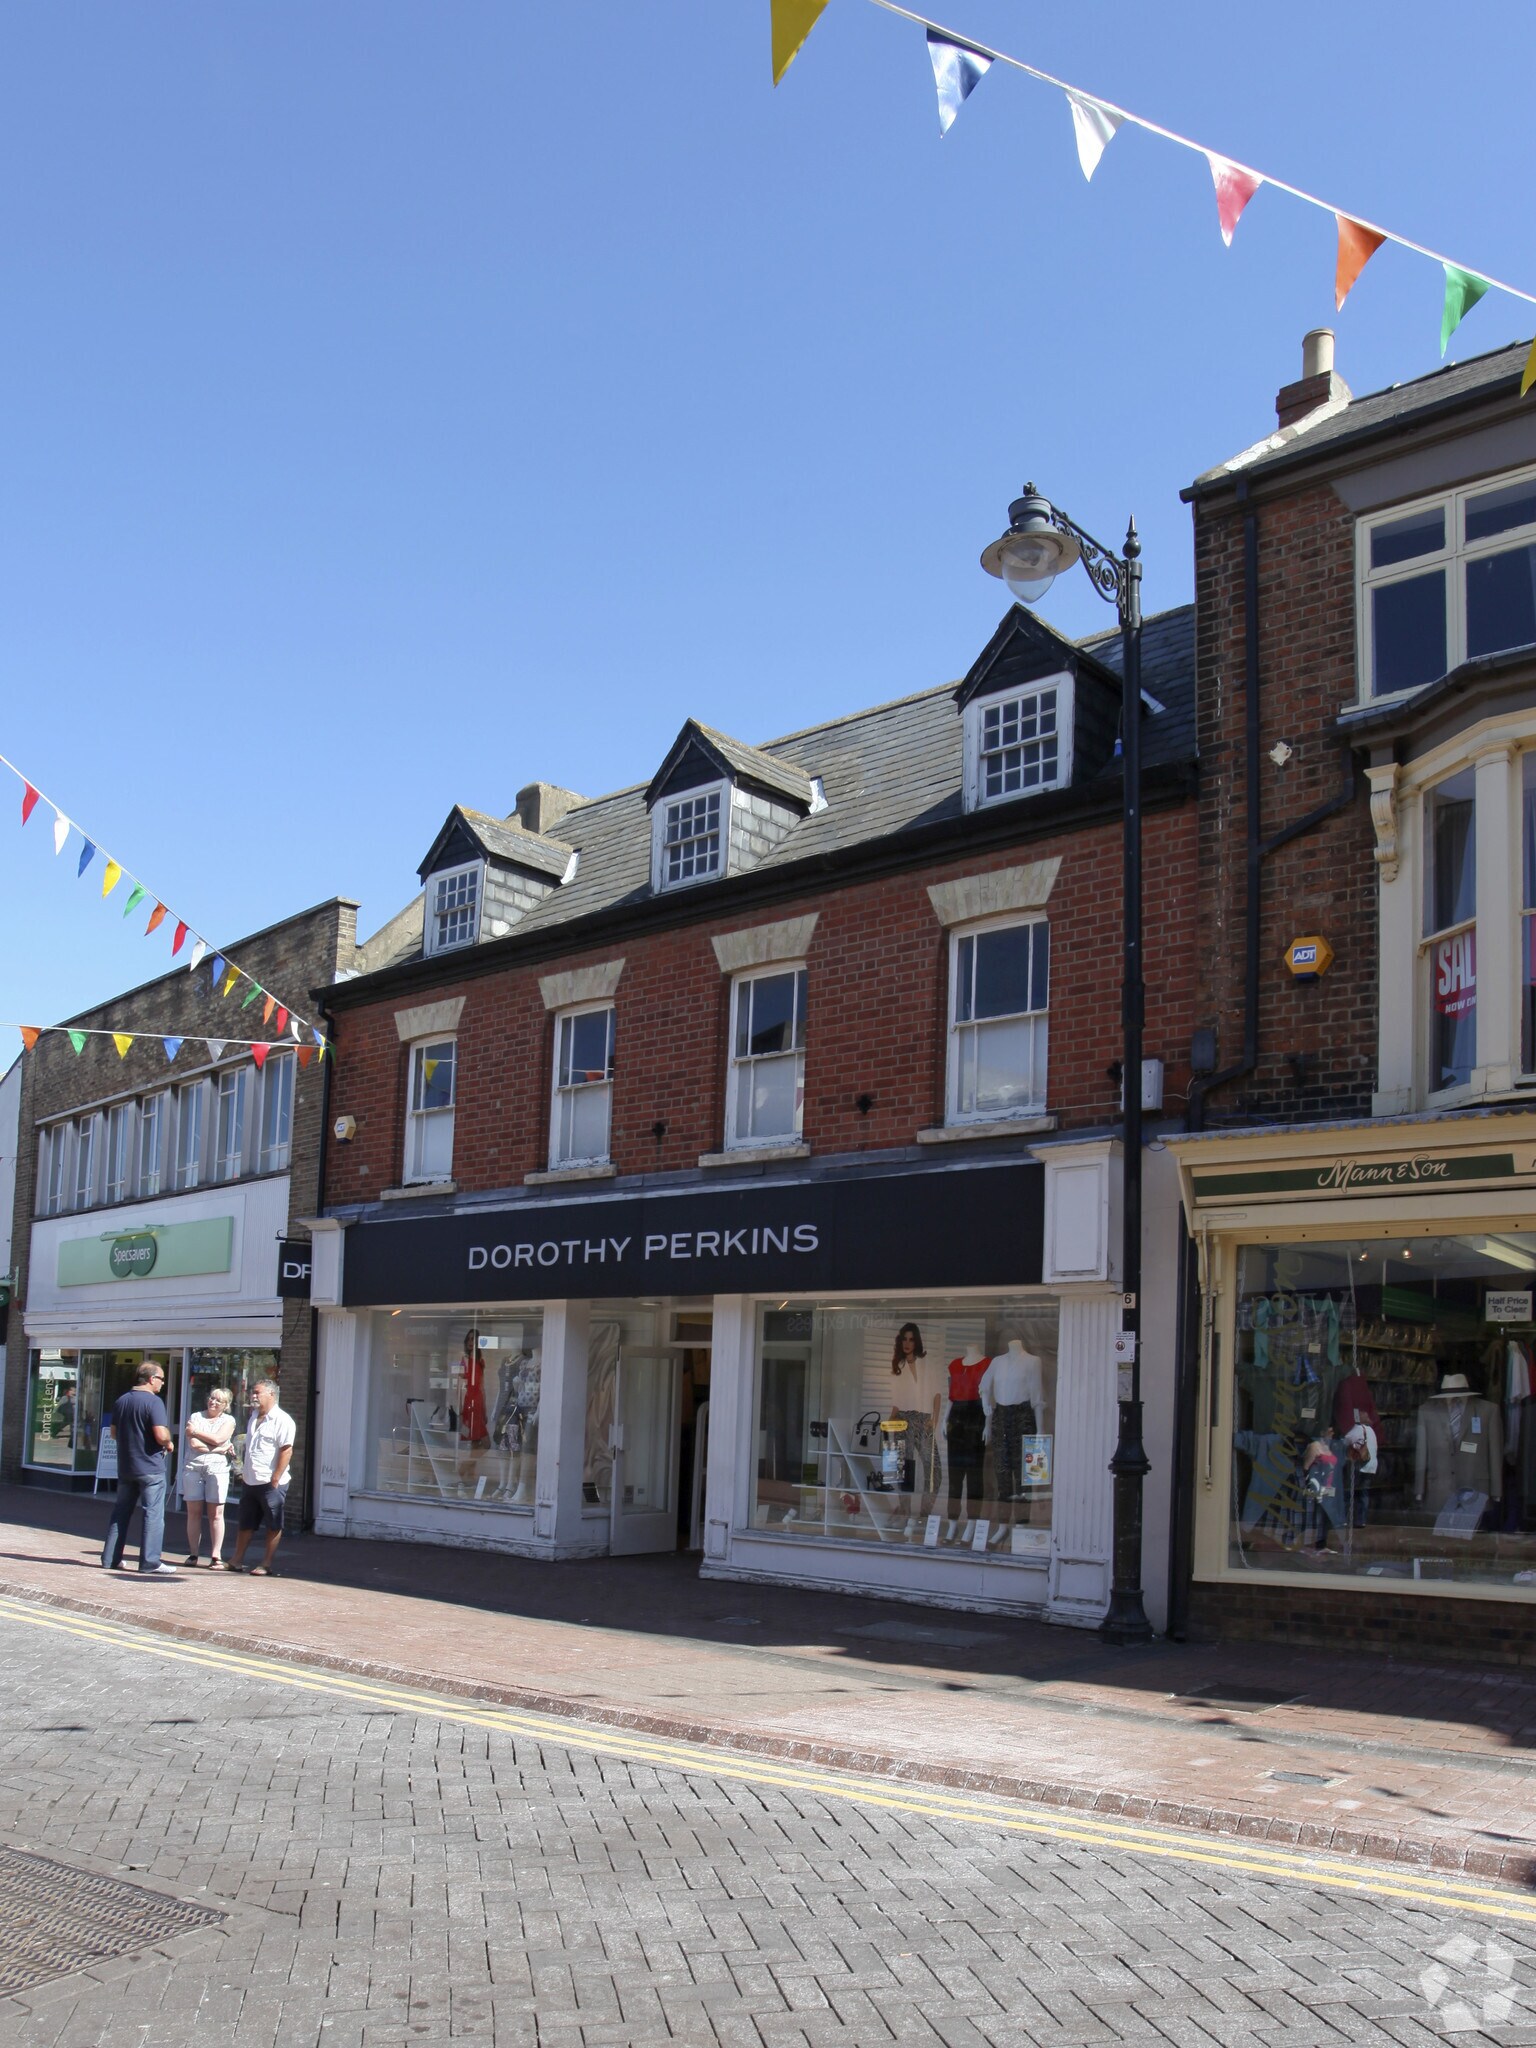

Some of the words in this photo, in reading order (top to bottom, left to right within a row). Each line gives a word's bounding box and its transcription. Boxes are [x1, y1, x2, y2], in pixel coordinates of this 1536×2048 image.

[1294, 949, 1316, 961] ADT
[1439, 930, 1477, 996] SAL
[1445, 1000, 1466, 1014] NOW
[1317, 1158, 1394, 1194] Mann
[1408, 1153, 1451, 1180] Son
[468, 1236, 632, 1271] DOROTHY
[644, 1223, 820, 1261] PERKINS
[113, 1247, 151, 1265] Specsavers
[1124, 1293, 1132, 1305] 6
[1488, 1296, 1505, 1305] Half
[1507, 1296, 1529, 1305] Price
[1491, 1305, 1503, 1313] To
[1504, 1305, 1528, 1313] Clear
[39, 1403, 53, 1442] Contact
